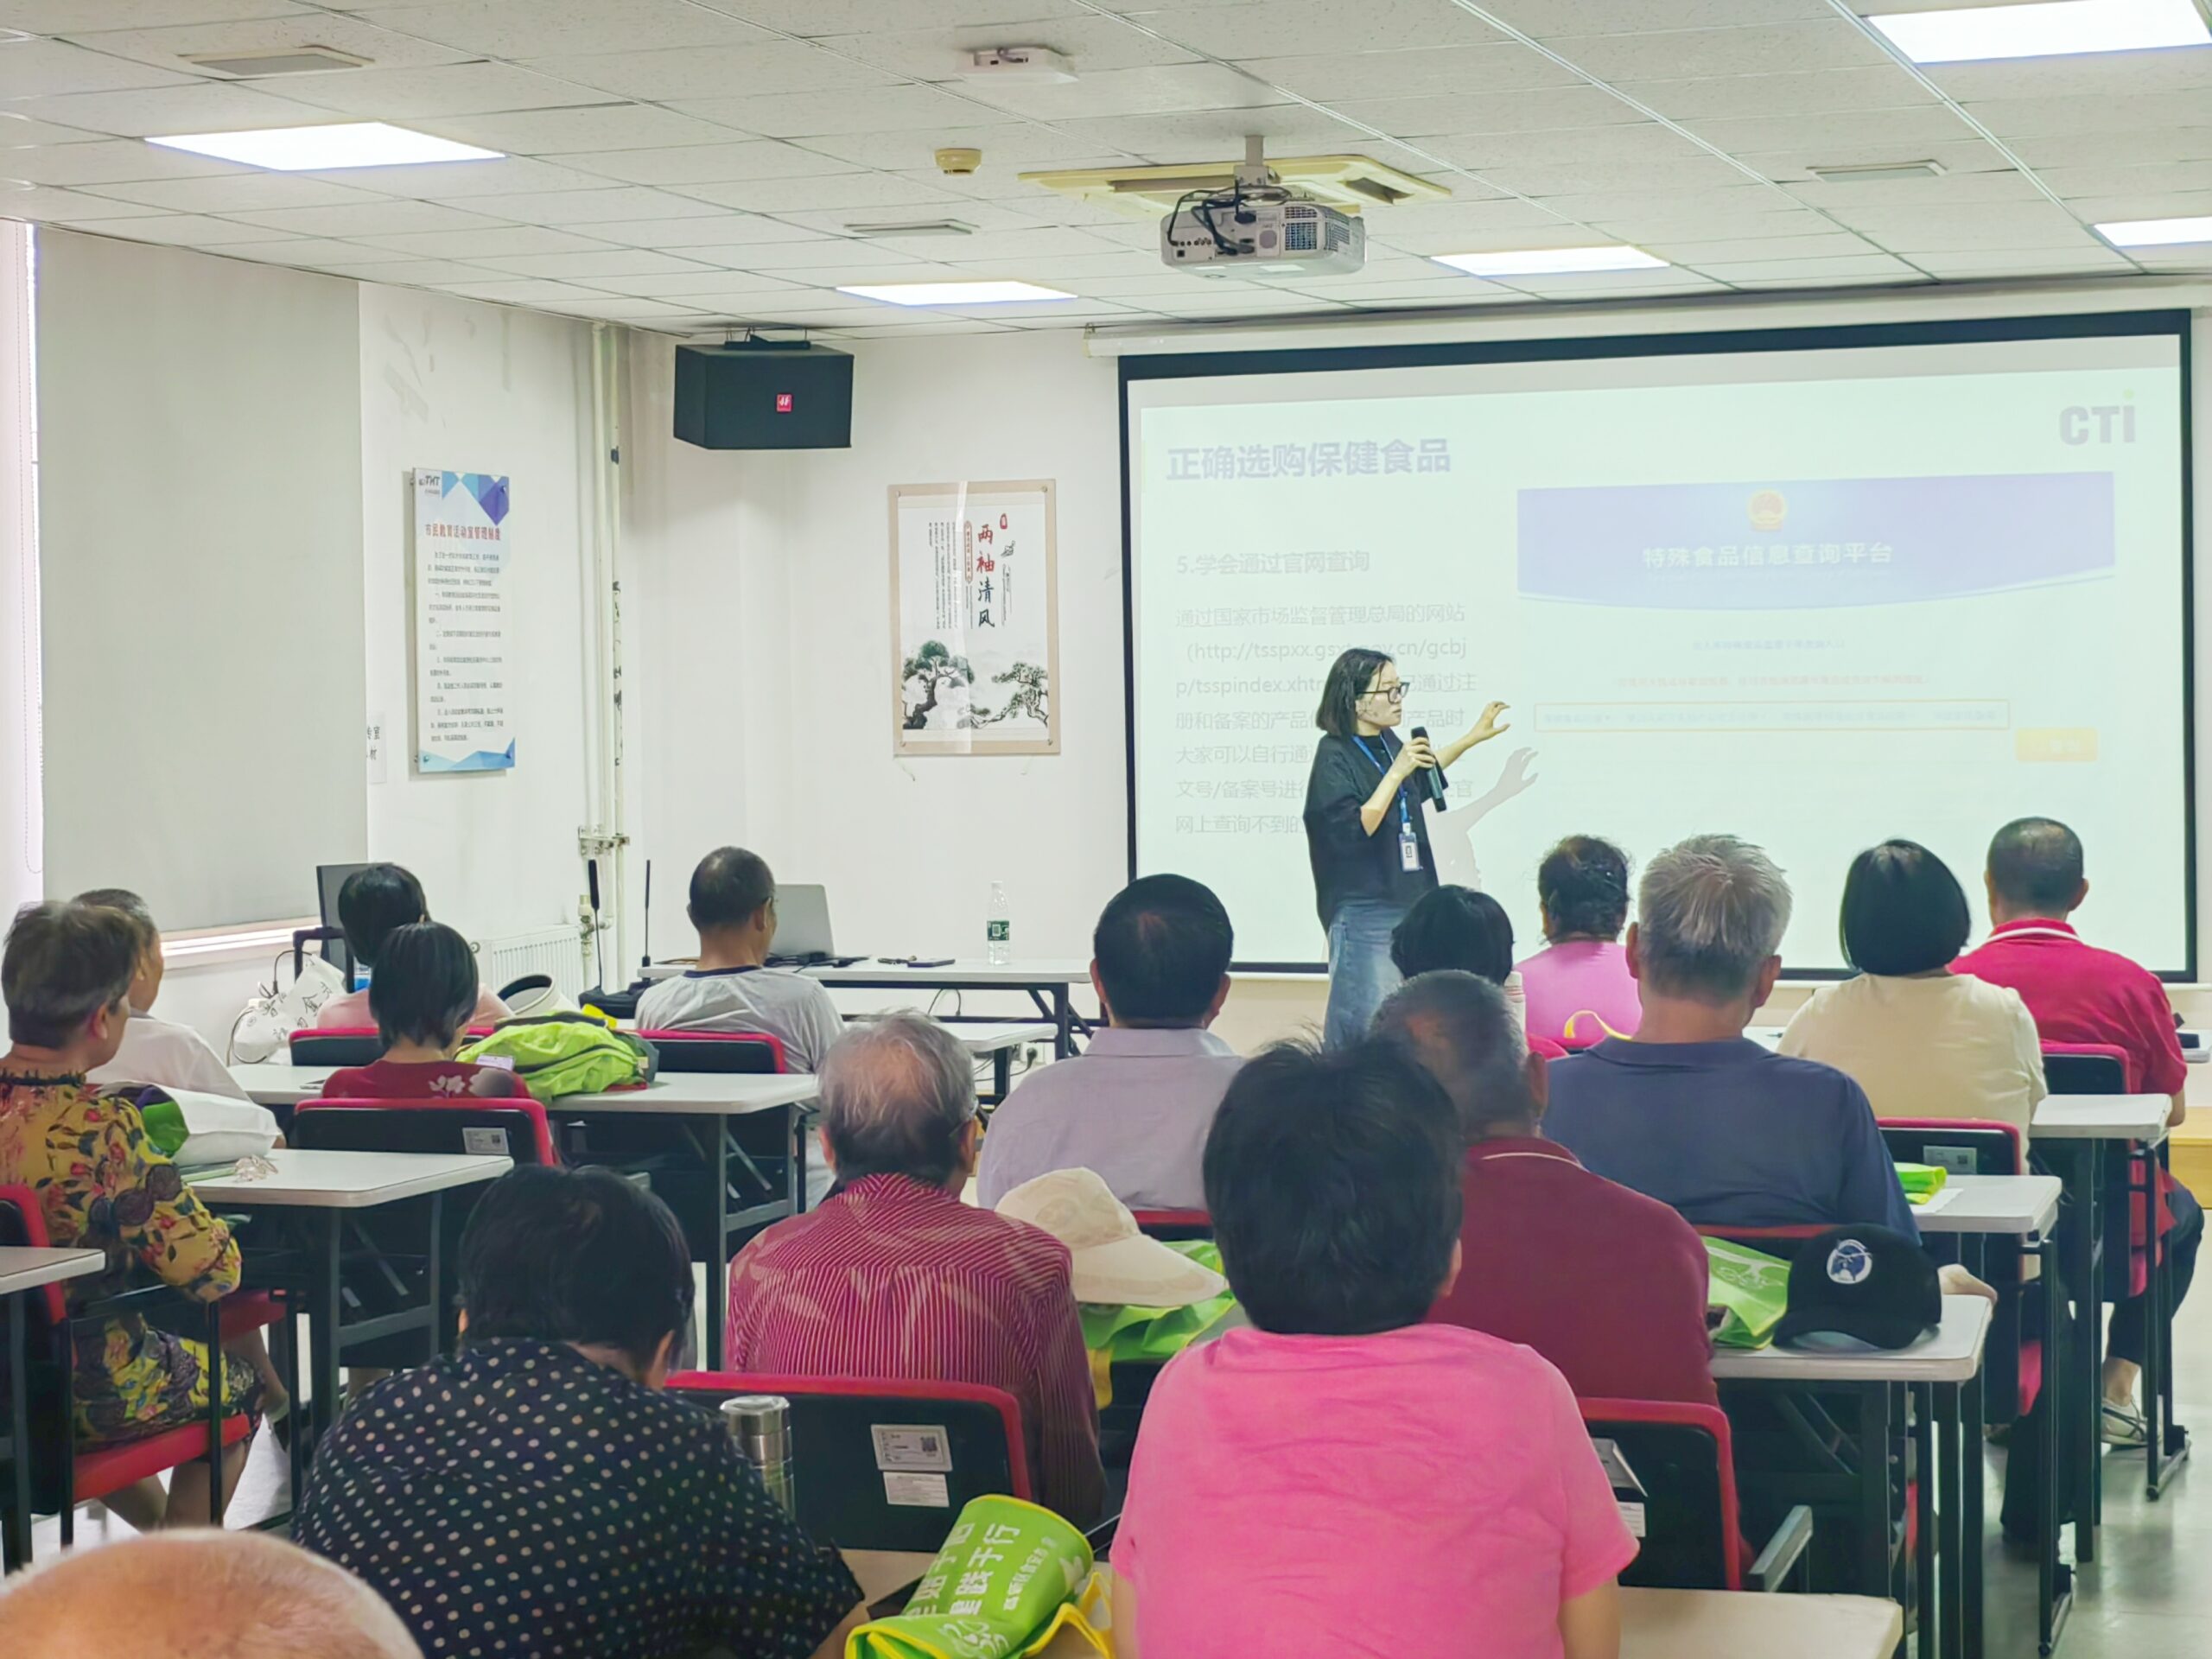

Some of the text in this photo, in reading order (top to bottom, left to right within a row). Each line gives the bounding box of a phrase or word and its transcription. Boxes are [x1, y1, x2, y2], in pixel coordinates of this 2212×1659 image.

[1166, 439, 1451, 480] 正确选购保健食品
[1176, 550, 1370, 575] 5.学会通过官网查询
[1643, 542, 1893, 569] 特殊食品信息查询平台
[976, 524, 995, 628] 两袖清风
[1175, 603, 1465, 628] 通过国家市场监督管理总局的网站
